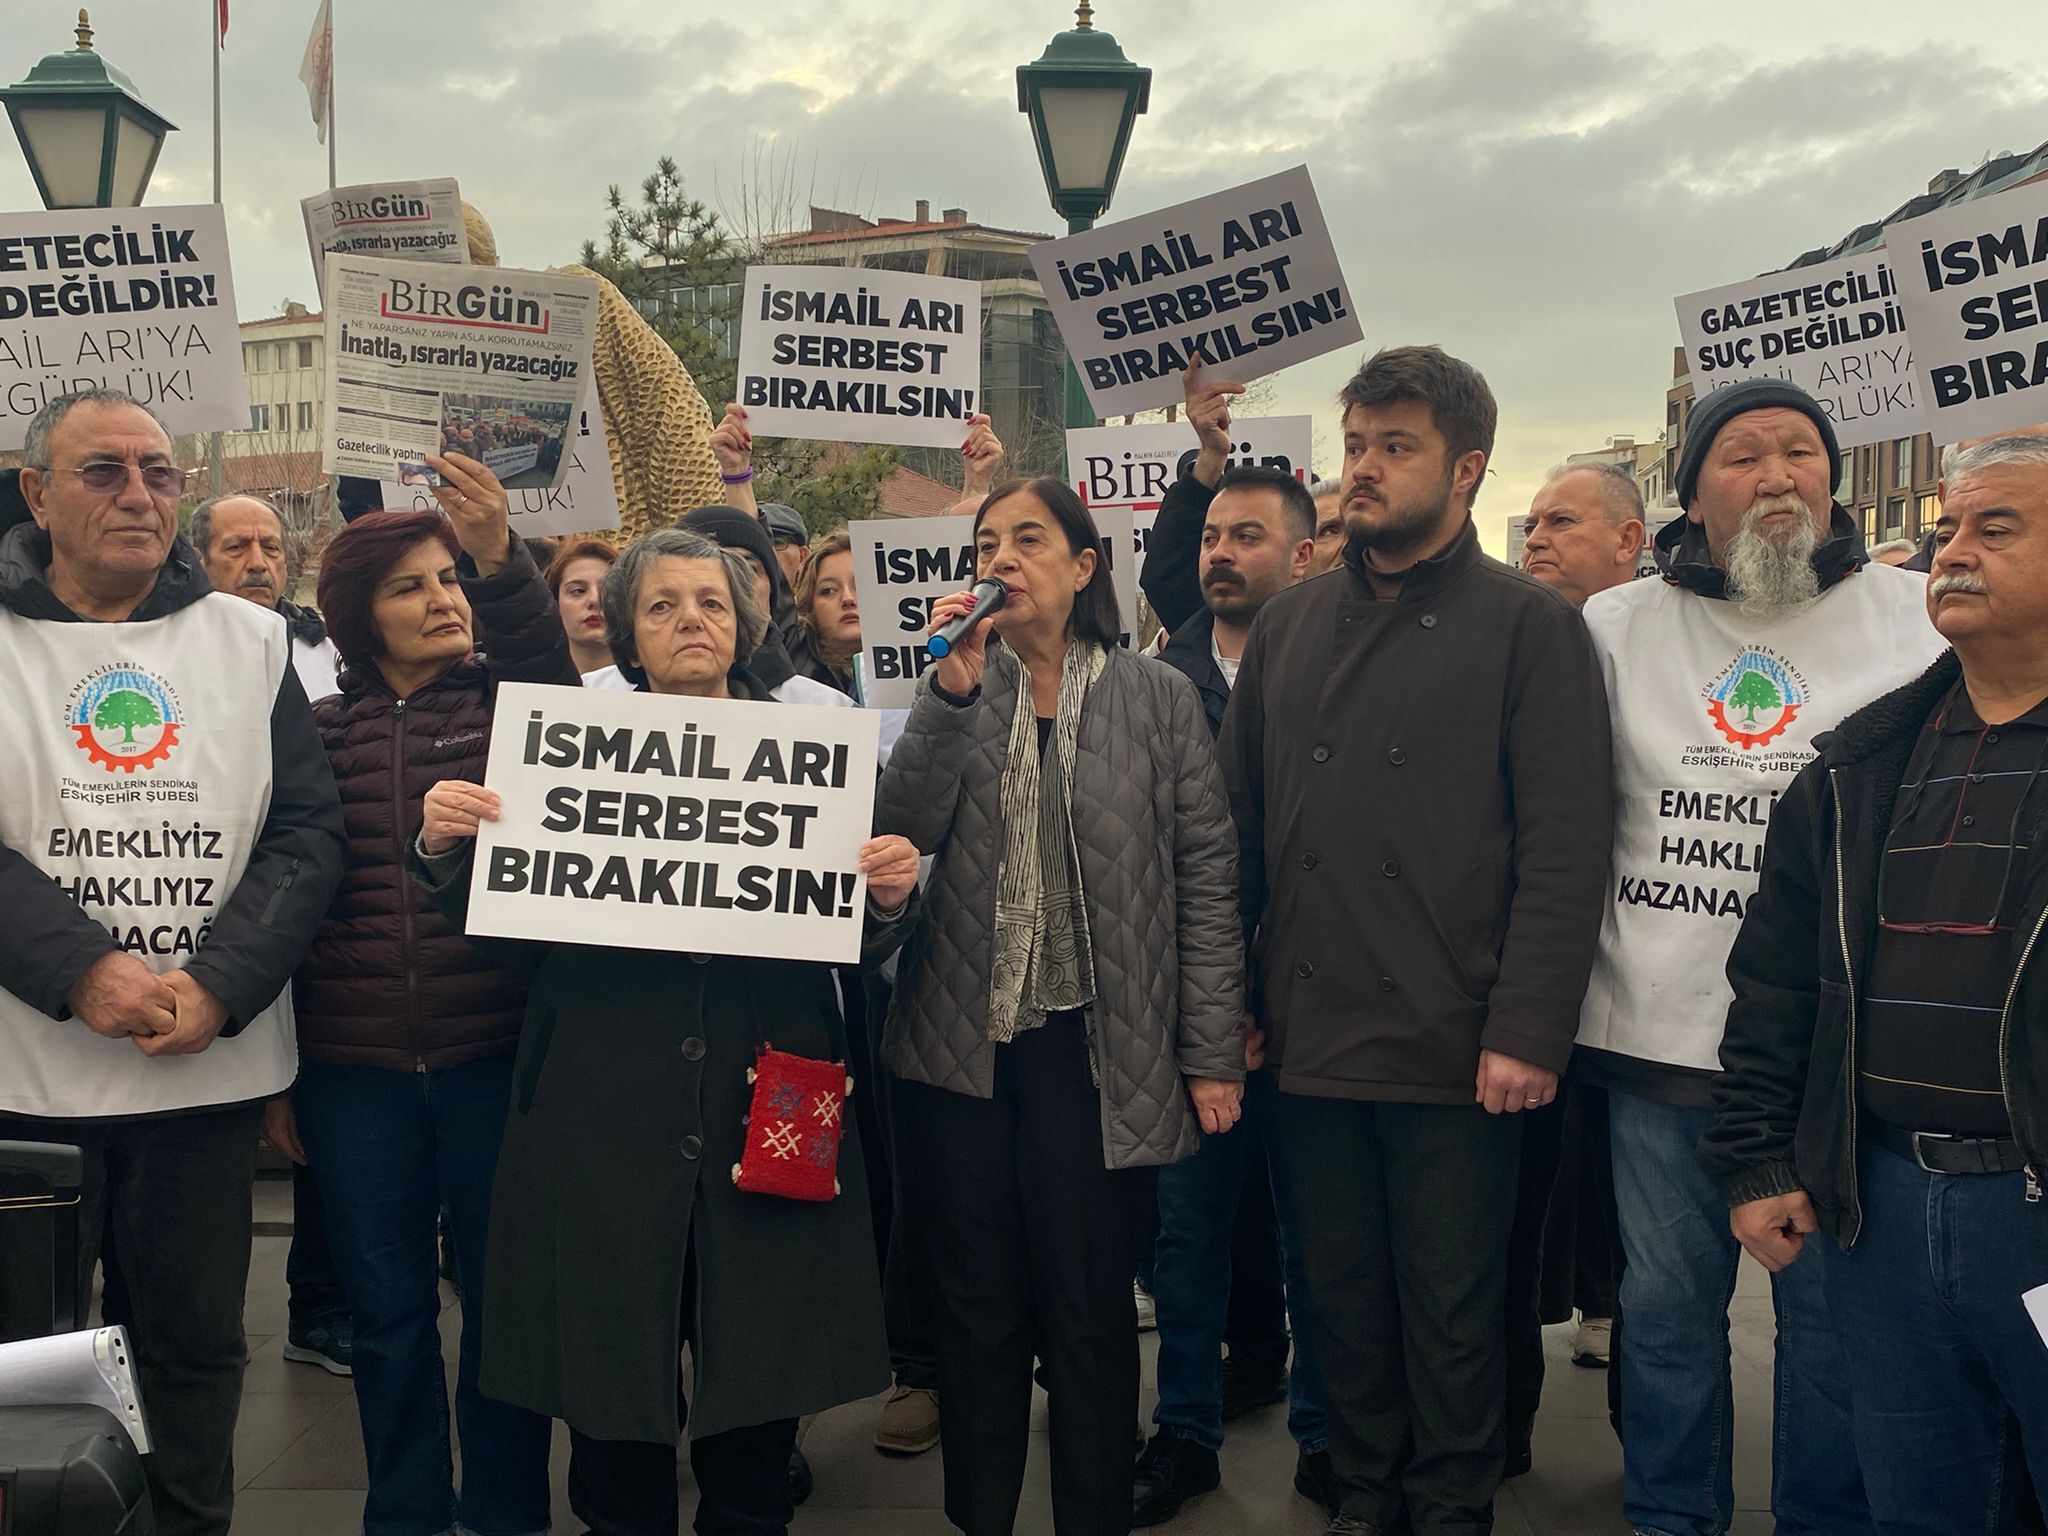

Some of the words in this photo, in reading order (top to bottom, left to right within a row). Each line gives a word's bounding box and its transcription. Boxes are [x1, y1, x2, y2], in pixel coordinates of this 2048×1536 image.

[352, 234, 391, 250] ısrarla
[392, 231, 458, 252] yazacağız
[1056, 230, 1213, 301] İSMAİL
[1223, 201, 1303, 260] ARI
[760, 284, 891, 328] İSMAİL
[898, 298, 964, 334] ARI
[1096, 255, 1292, 341] SERBEST
[76, 323, 212, 365] ARI'YA
[340, 323, 407, 365] İnatla,
[410, 344, 478, 369] ısrarla
[480, 351, 579, 383] yazacağız
[351, 319, 366, 330] NE
[367, 321, 427, 339] YAPARSANIZ
[429, 329, 459, 340] YAPIN
[460, 332, 486, 343] ASLA
[487, 335, 573, 353] KORKUTAMAZSINIZ
[772, 334, 948, 375] SERBEST
[1083, 287, 1348, 391] BIRAKILSIN!
[1698, 337, 1757, 371] SUÇ
[743, 376, 974, 420] BIRAKILSIN!
[337, 437, 391, 457] Gazetecilik
[393, 448, 426, 462] yaptım
[523, 710, 730, 780] İSMAİL
[742, 738, 848, 788] ARI
[1681, 755, 1754, 770] ESKİŞEHİR
[1685, 745, 1703, 754] TÜM
[1764, 750, 1815, 760] SENDİKASI
[60, 788, 141, 806] ESKİŞEHİR
[146, 790, 199, 803] ŞUBESİ
[62, 777, 80, 788] TÜM
[82, 779, 147, 792] EMEKLİLERİN
[150, 778, 198, 790] SENDİKASI
[540, 786, 818, 850] SERBEST
[48, 820, 223, 859] EMEKLİYİZ
[54, 876, 214, 907] HAKLIYIZ
[487, 845, 857, 919] BIRAKILSIN!
[1618, 875, 1751, 919] KAZANA
